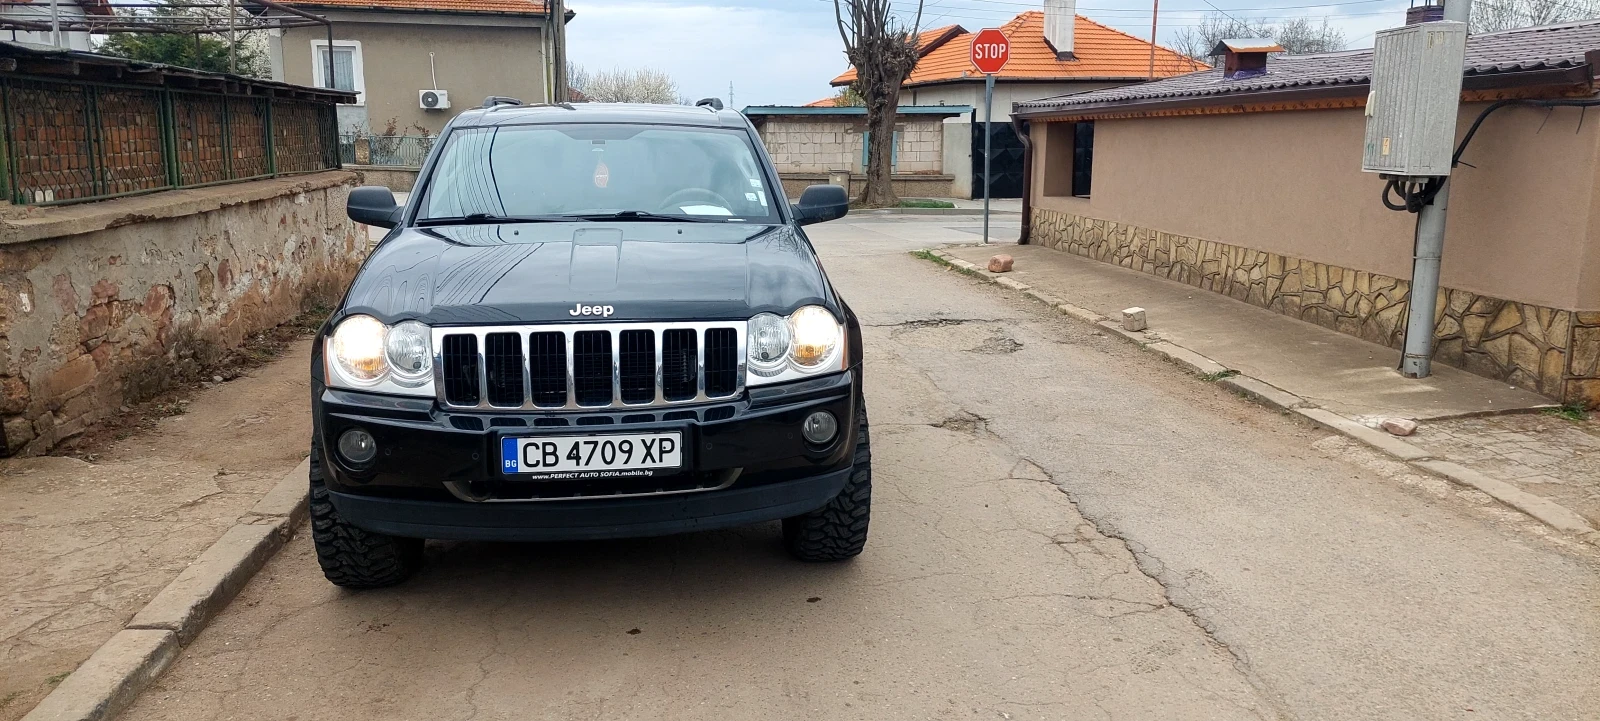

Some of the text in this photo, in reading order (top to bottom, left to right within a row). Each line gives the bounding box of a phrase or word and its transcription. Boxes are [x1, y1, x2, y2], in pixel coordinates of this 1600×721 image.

[975, 43, 1006, 59] STOP
[569, 303, 614, 318] Jeep
[522, 437, 676, 468] CB 4709 XP
[505, 460, 517, 468] BG
[532, 472, 578, 480] www.PERFECT
